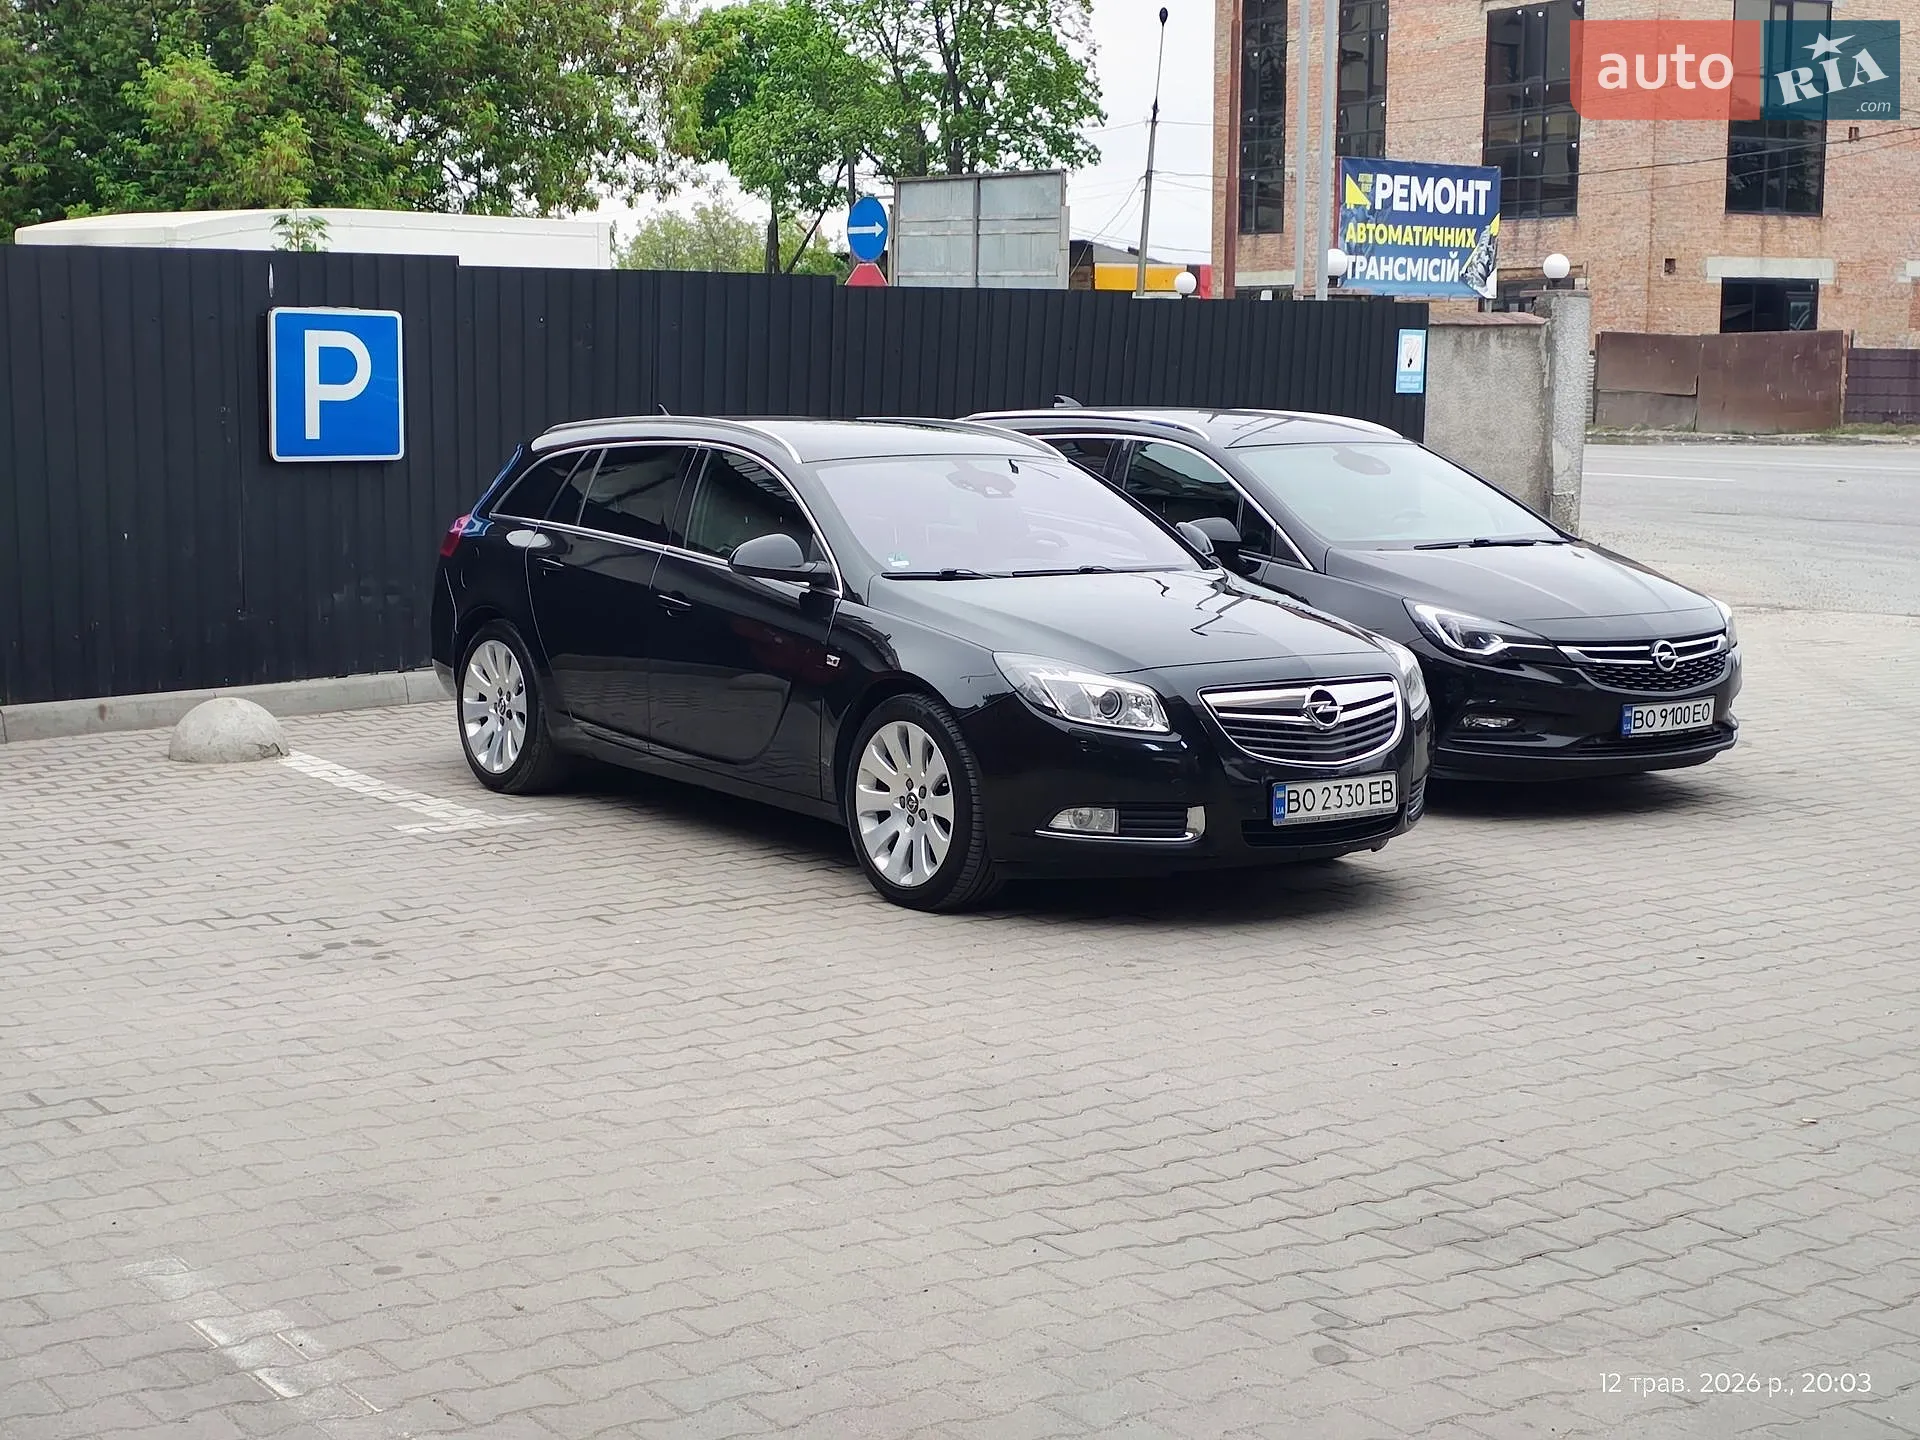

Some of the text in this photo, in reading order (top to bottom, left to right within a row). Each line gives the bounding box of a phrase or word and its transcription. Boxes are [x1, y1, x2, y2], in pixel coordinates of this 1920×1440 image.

[1375, 174, 1491, 215] РЕМОНТ
[1345, 222, 1477, 248] АВТОМАТИЧНИХ
[1346, 251, 1460, 283] ТРАНСМІСІЙ
[304, 329, 371, 439] P
[1633, 703, 1710, 730] BO 9100 EO
[1275, 806, 1285, 815] UA
[1287, 780, 1394, 813] BO 2330 EB
